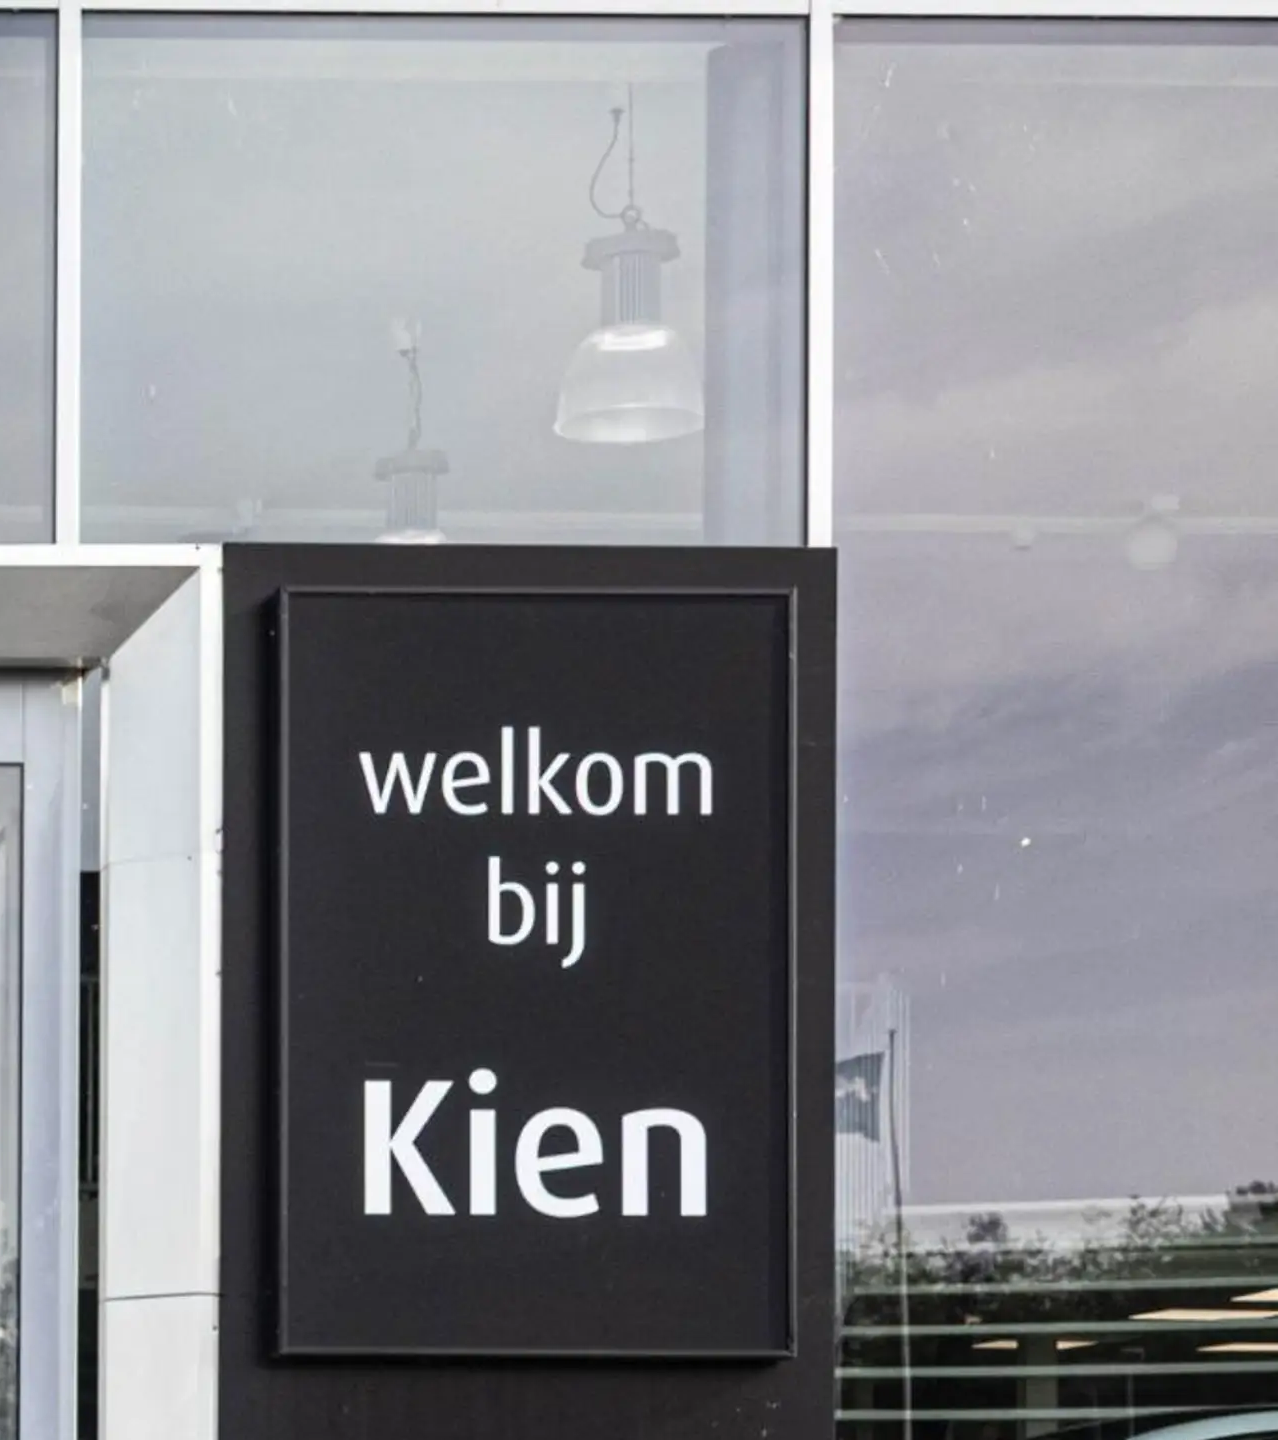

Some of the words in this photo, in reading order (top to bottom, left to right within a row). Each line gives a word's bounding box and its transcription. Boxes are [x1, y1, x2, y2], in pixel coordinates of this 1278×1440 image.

[358, 726, 714, 817] welkom
[488, 855, 587, 969] bij
[363, 1068, 708, 1218] Kien
